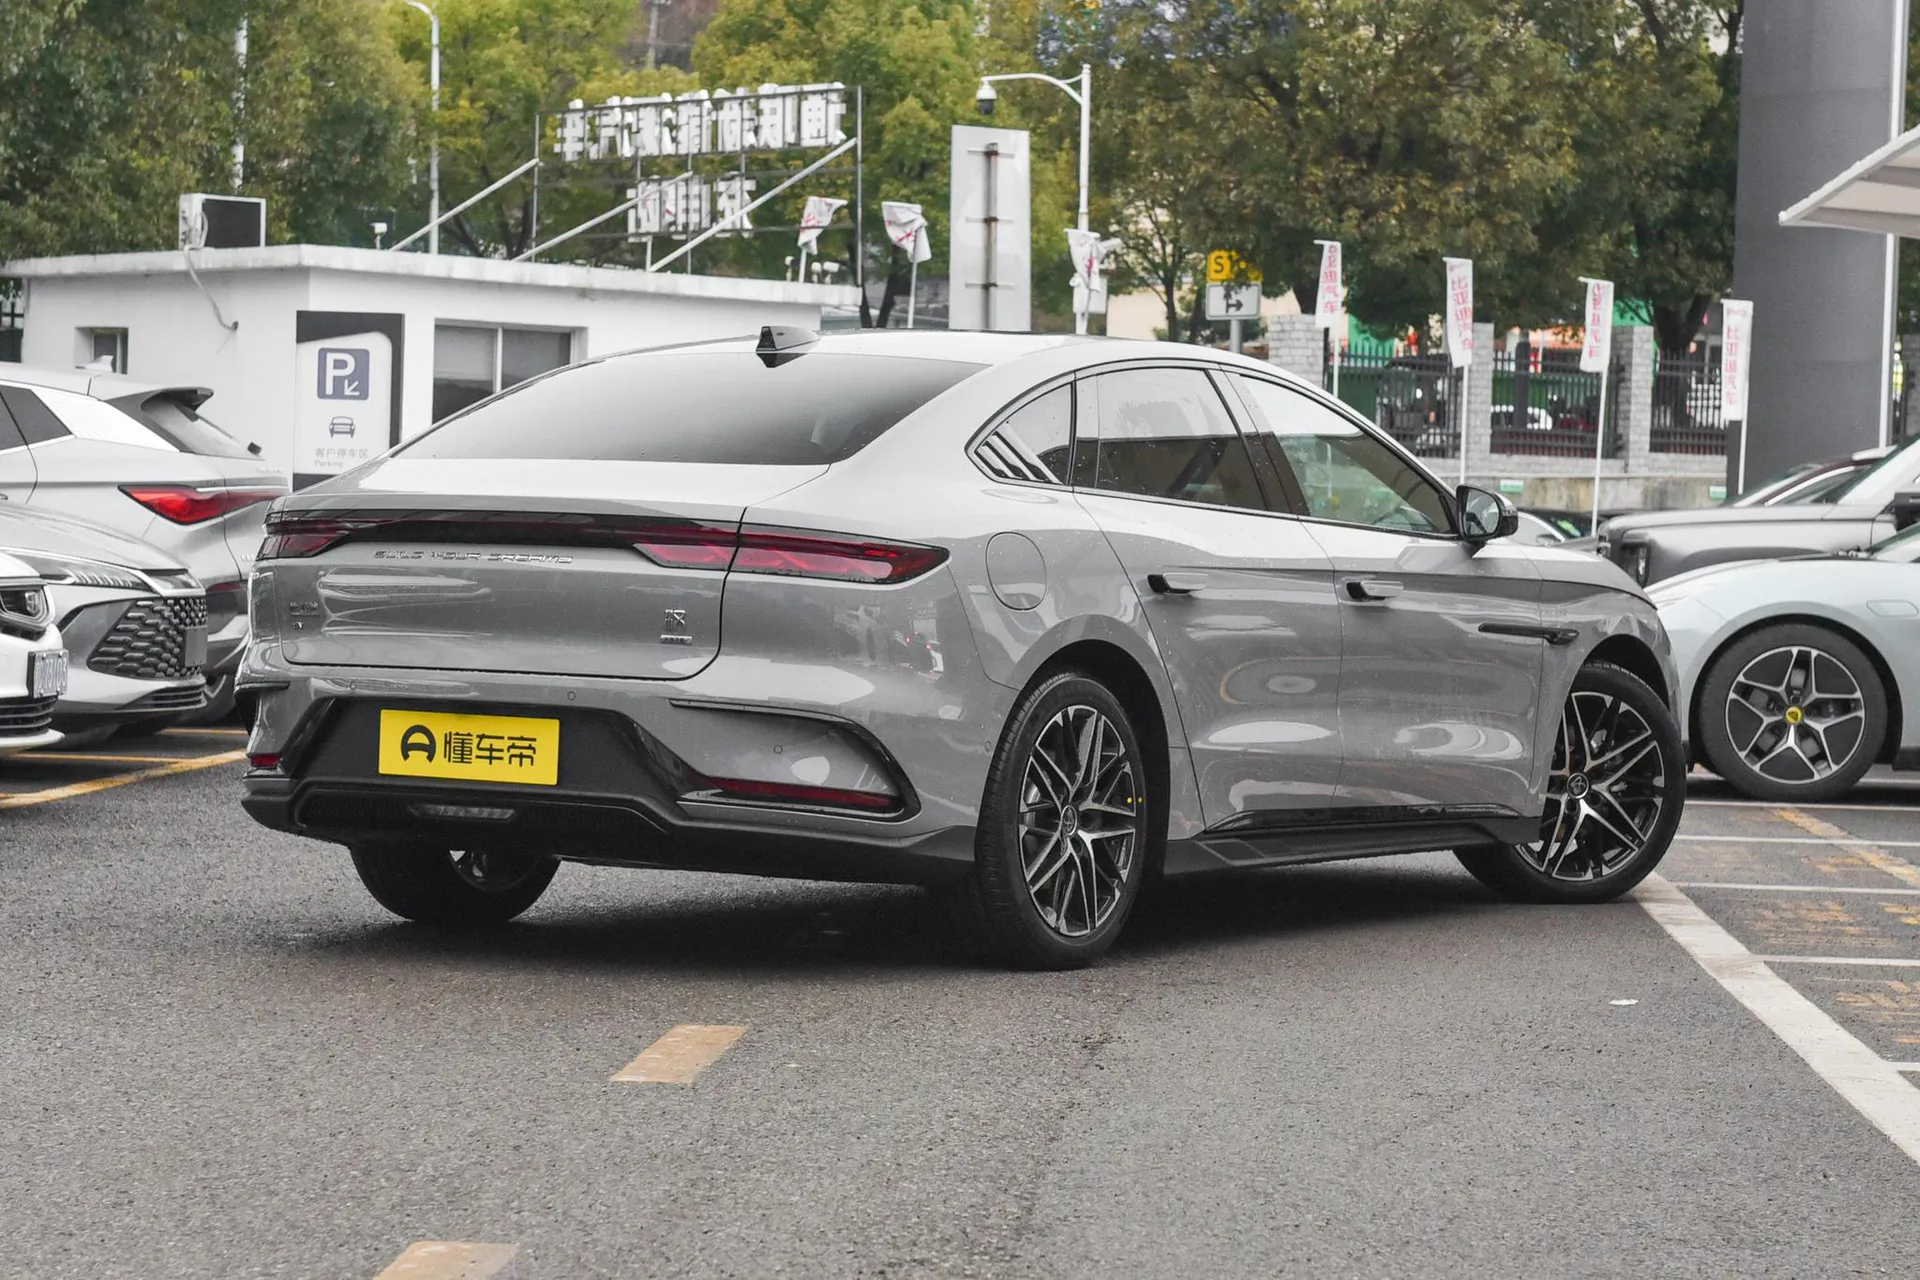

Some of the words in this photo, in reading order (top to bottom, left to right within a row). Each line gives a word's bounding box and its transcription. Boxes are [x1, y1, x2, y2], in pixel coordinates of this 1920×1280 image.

[325, 352, 356, 395] P
[1724, 324, 1739, 406] 比亚迪汽车
[314, 459, 344, 468] Parking
[315, 447, 369, 459] 客户停车区
[430, 551, 481, 561] YOUR
[443, 731, 538, 768] 懂车帝
